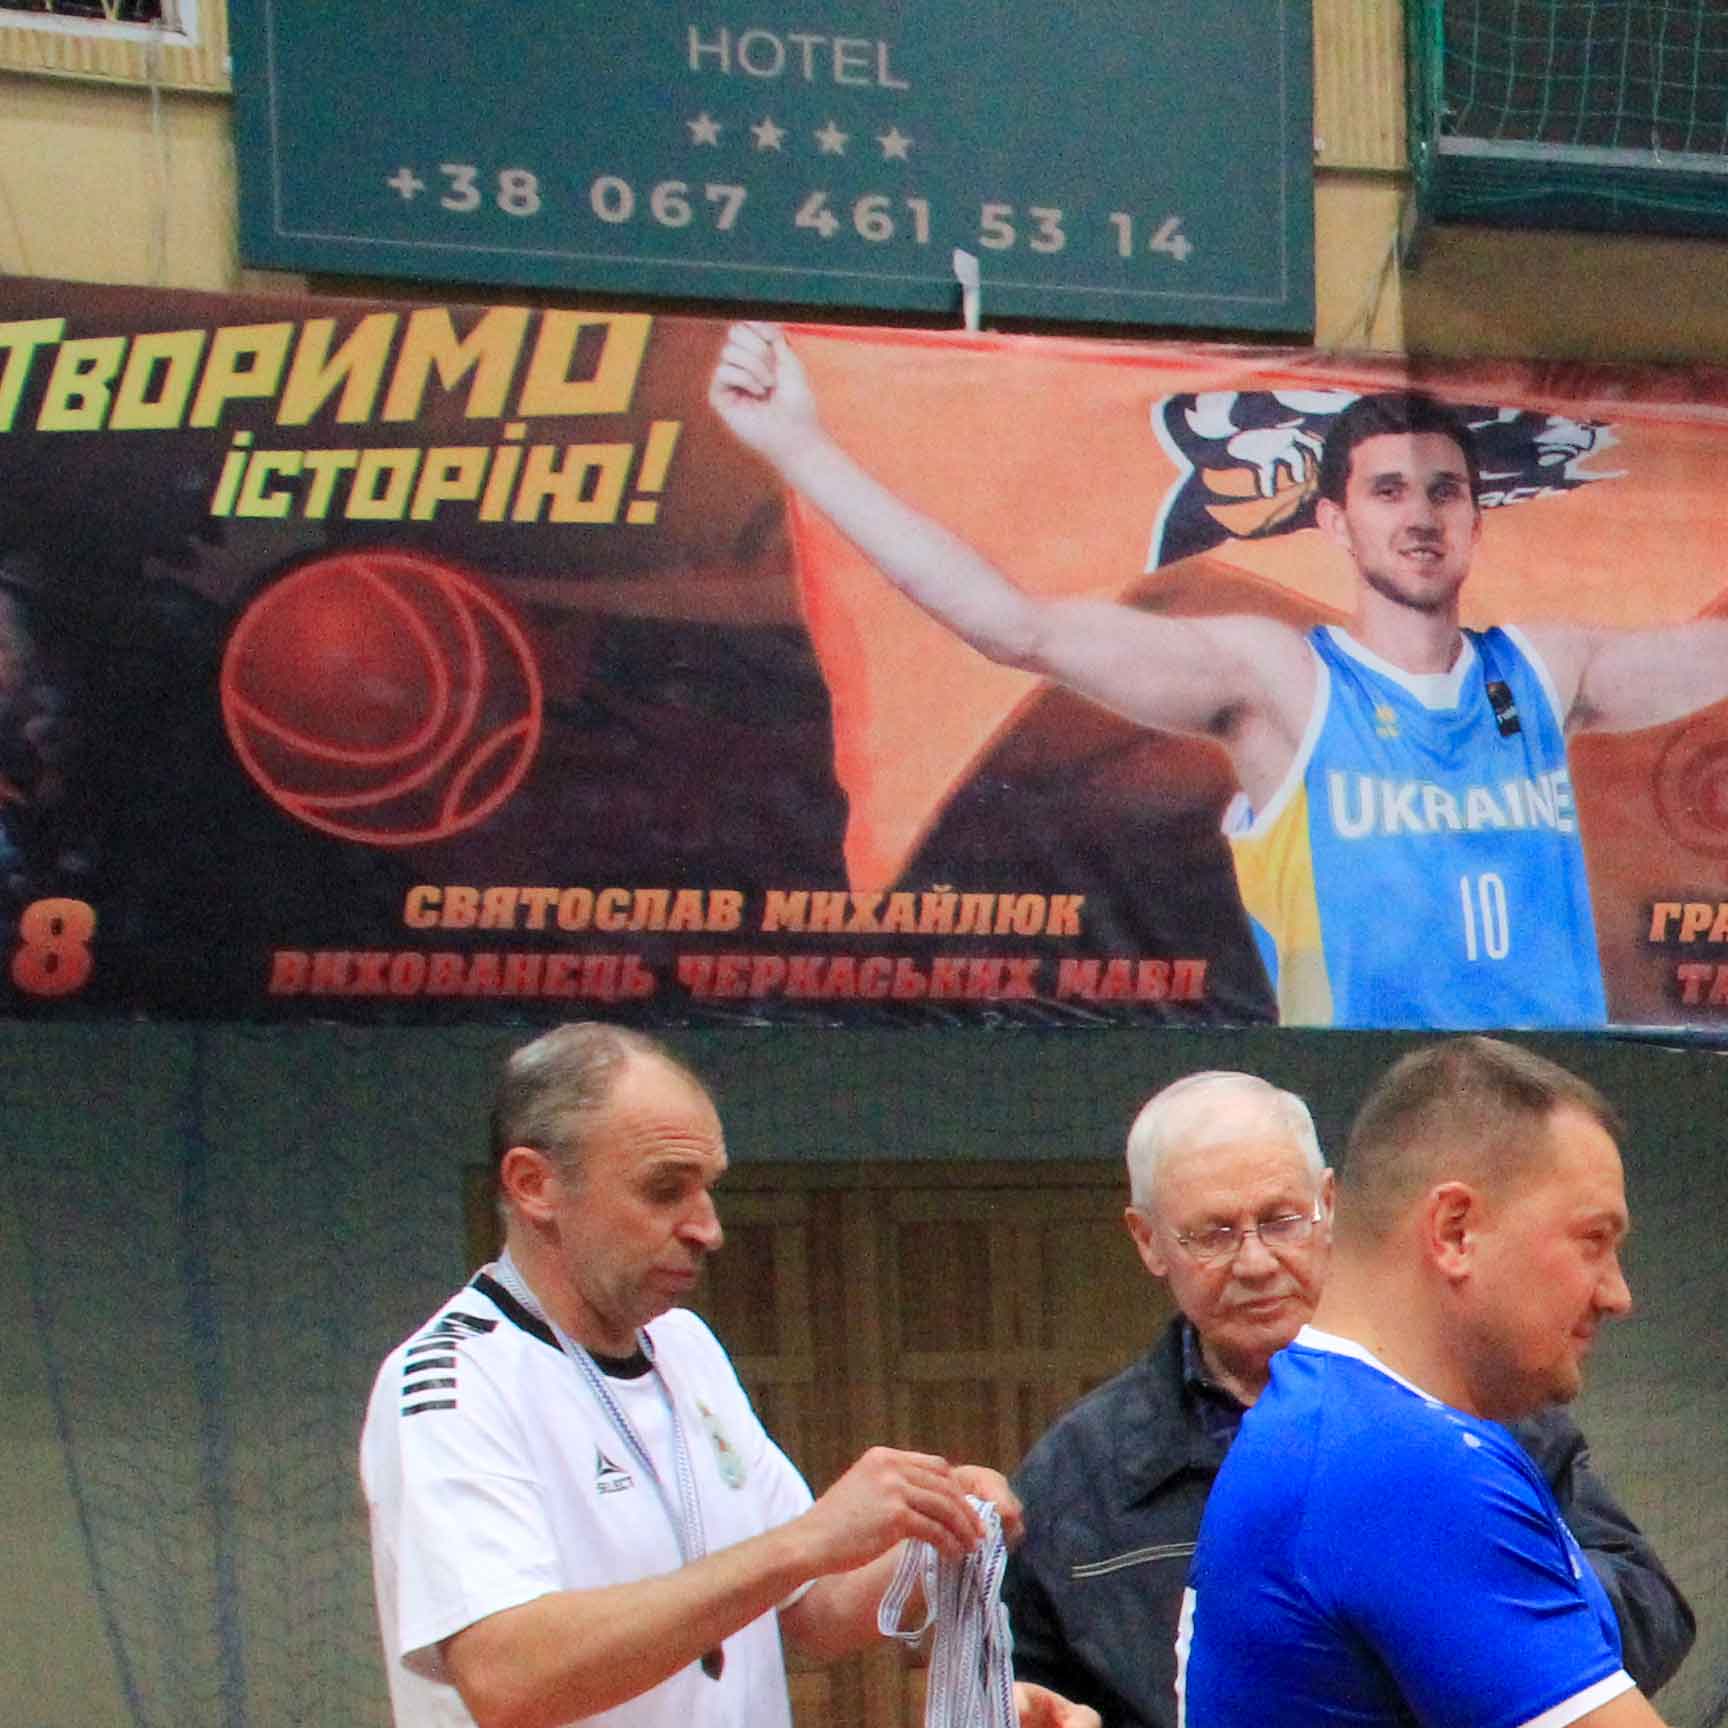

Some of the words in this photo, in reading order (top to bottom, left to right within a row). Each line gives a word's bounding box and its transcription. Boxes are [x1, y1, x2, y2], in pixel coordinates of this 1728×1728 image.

[687, 24, 910, 90] HOTEL
[386, 162, 541, 217] +38
[590, 174, 746, 231] 067
[795, 190, 930, 245] 461
[978, 204, 1066, 253] 53
[1107, 210, 1194, 263] 14
[1328, 768, 1574, 839] UKRAINE
[403, 884, 744, 932] СВЯТОСЛАВ
[760, 884, 1088, 936] МИХАЙЛЮК
[1459, 872, 1510, 961] 10
[10, 897, 97, 997] 8
[269, 948, 656, 1001] ВИХОВАНЕЦЬ
[676, 952, 1040, 1000] ЧЕРКАСЬКИХ
